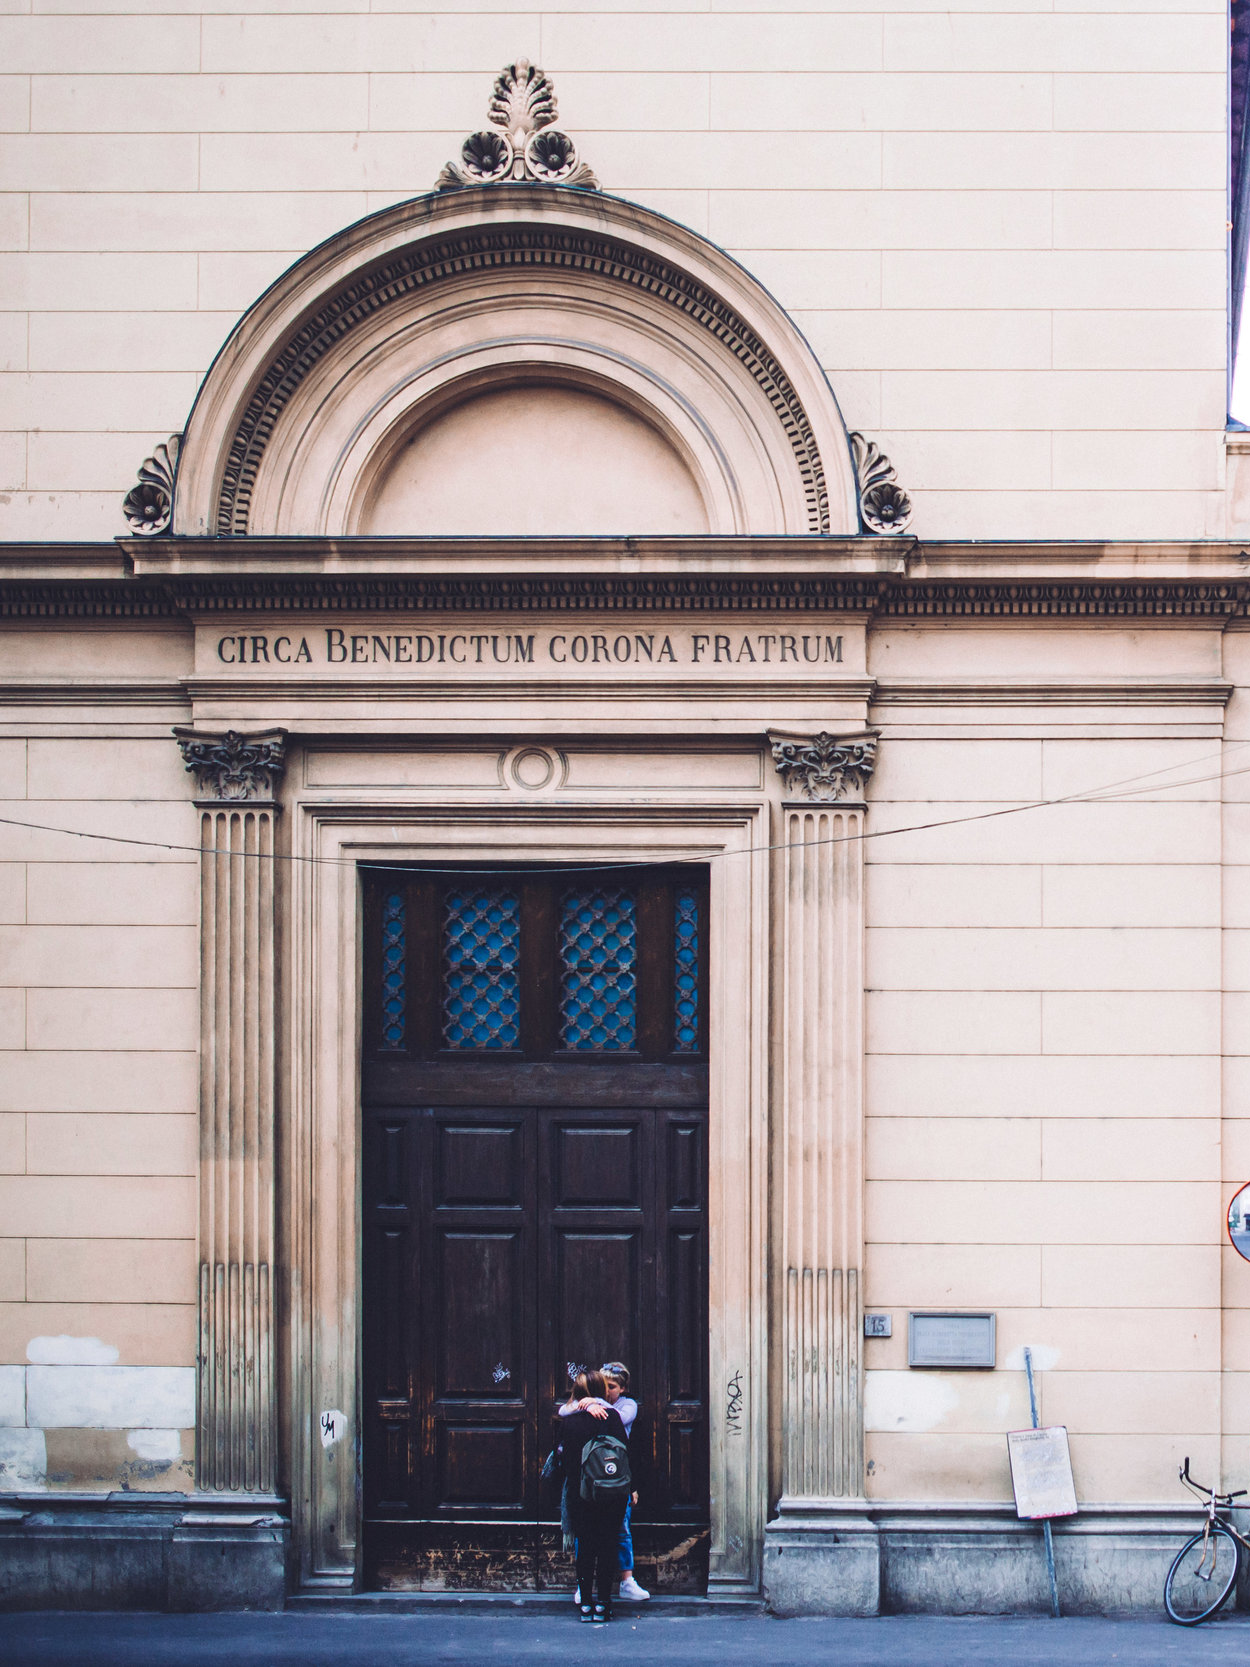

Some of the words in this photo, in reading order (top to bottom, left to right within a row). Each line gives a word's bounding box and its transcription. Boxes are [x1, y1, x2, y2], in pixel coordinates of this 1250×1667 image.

[217, 635, 313, 663] CIRCA
[325, 628, 535, 663] BENEDICTUM
[549, 635, 678, 663] CORONA
[691, 634, 844, 663] FRATRUM
[872, 1318, 885, 1333] 15
